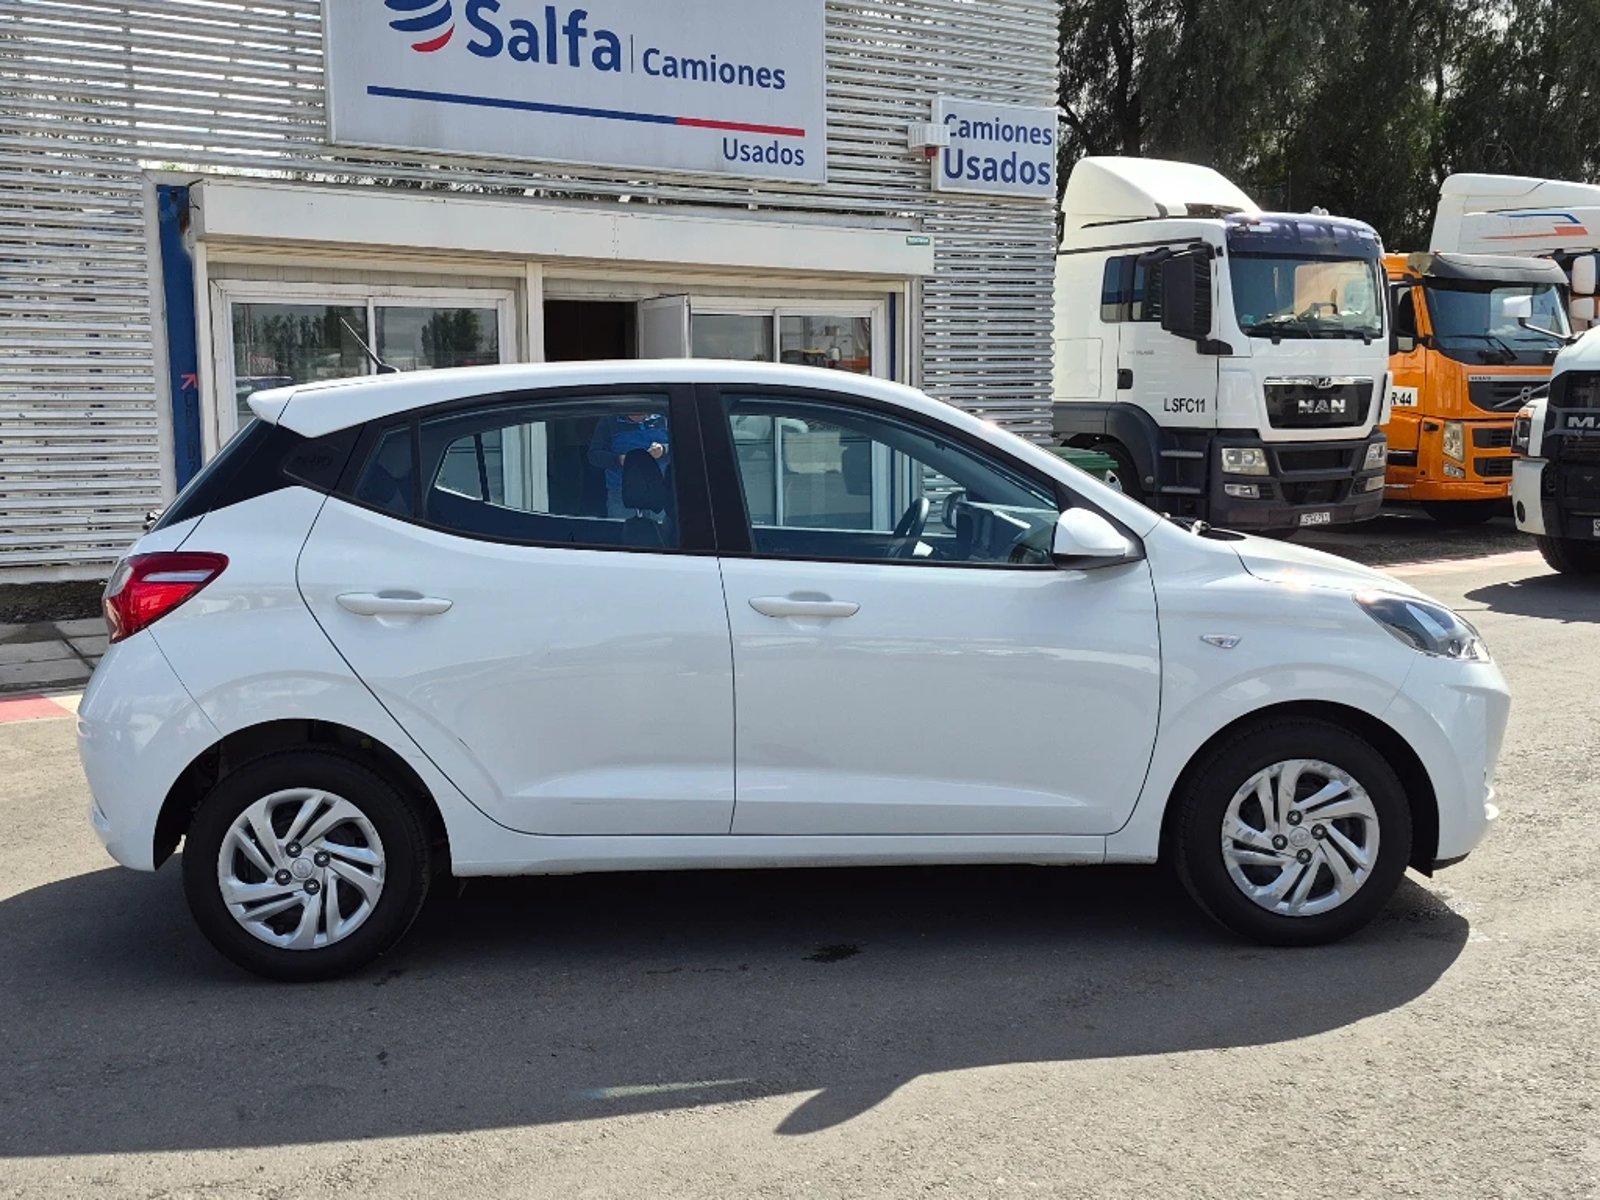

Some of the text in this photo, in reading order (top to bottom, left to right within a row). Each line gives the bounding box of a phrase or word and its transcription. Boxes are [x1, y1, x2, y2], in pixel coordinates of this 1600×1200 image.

[465, 0, 786, 90] Salfa Camiones
[722, 137, 805, 166] Usados
[944, 148, 1051, 185] Usados
[1163, 397, 1206, 413] LSFC11
[1298, 399, 1346, 413] MAN
